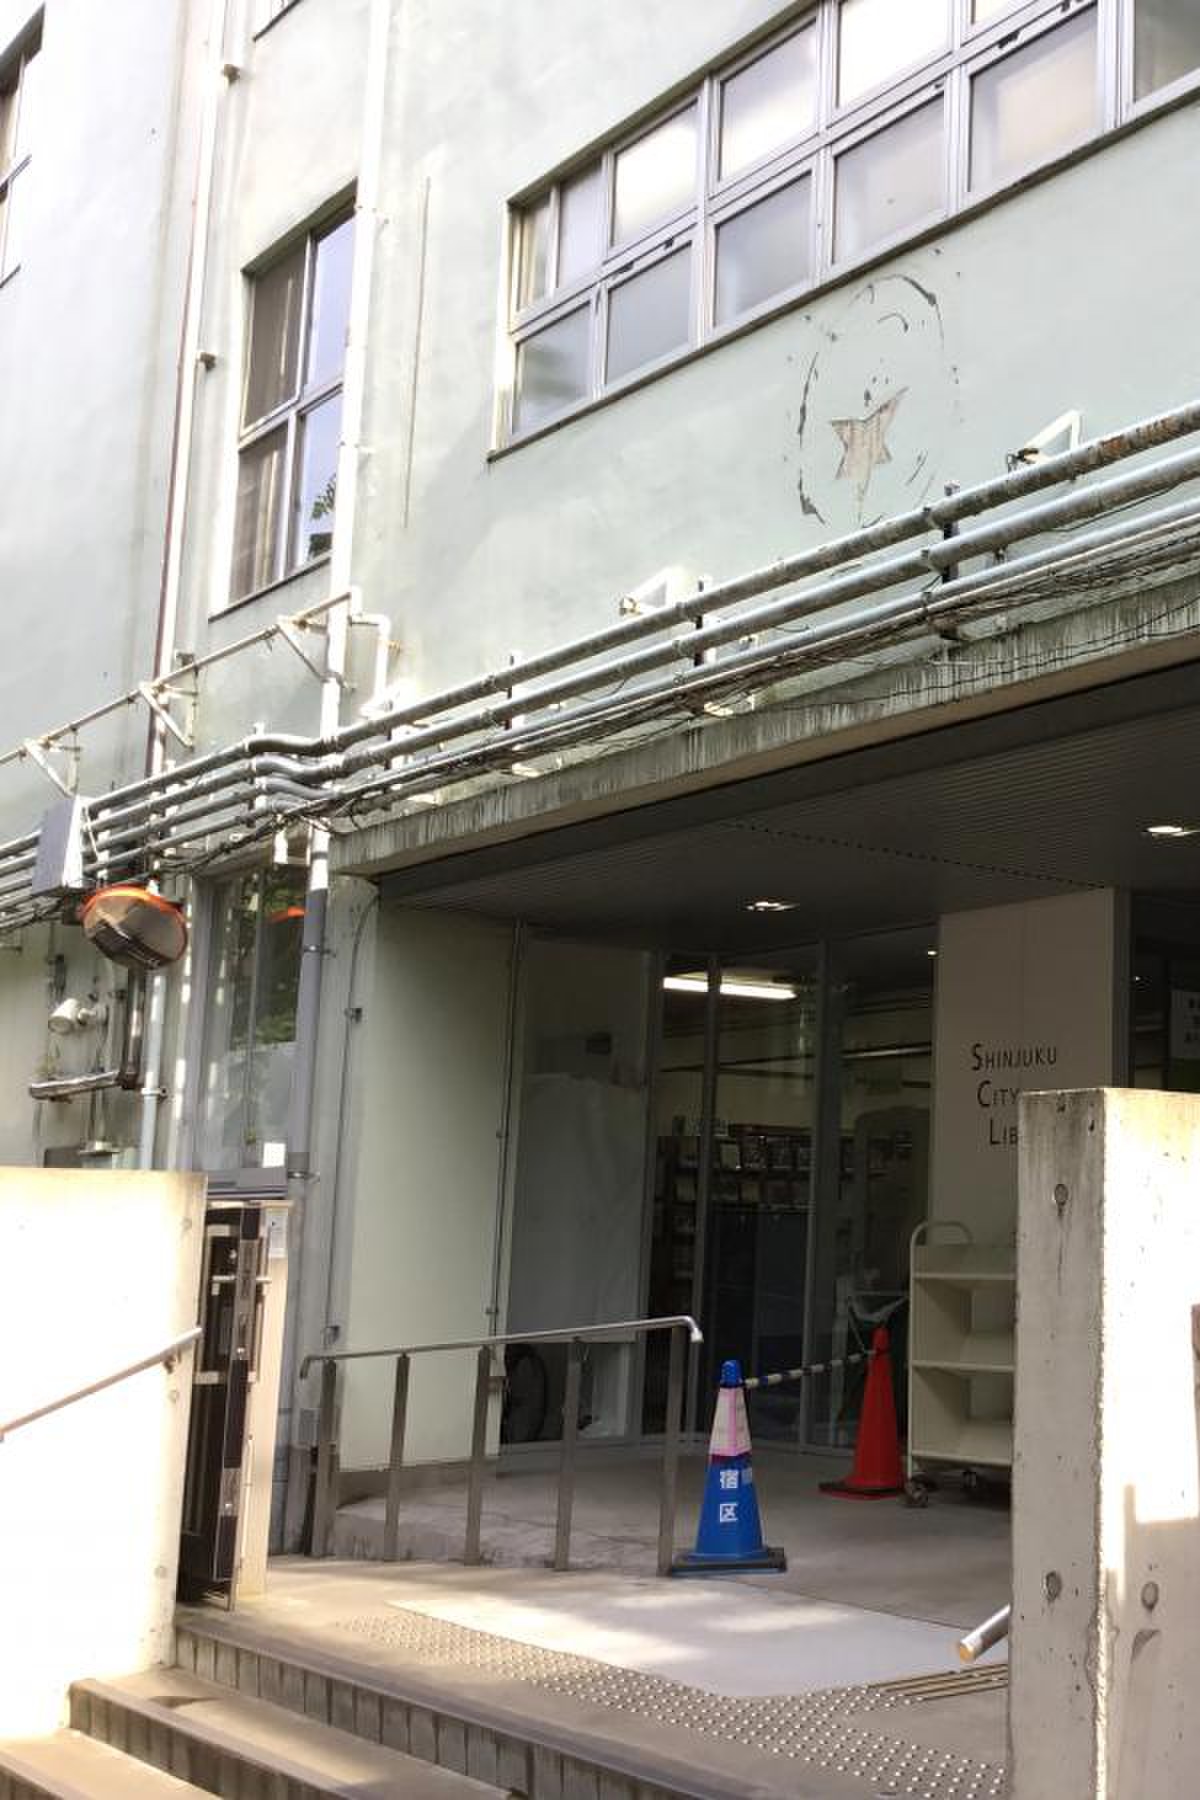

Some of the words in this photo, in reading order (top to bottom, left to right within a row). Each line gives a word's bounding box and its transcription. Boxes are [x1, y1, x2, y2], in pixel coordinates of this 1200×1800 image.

[971, 1043, 1057, 1071] SHINJUKU
[976, 1080, 1020, 1108] CITY
[989, 1119, 1018, 1146] LIB
